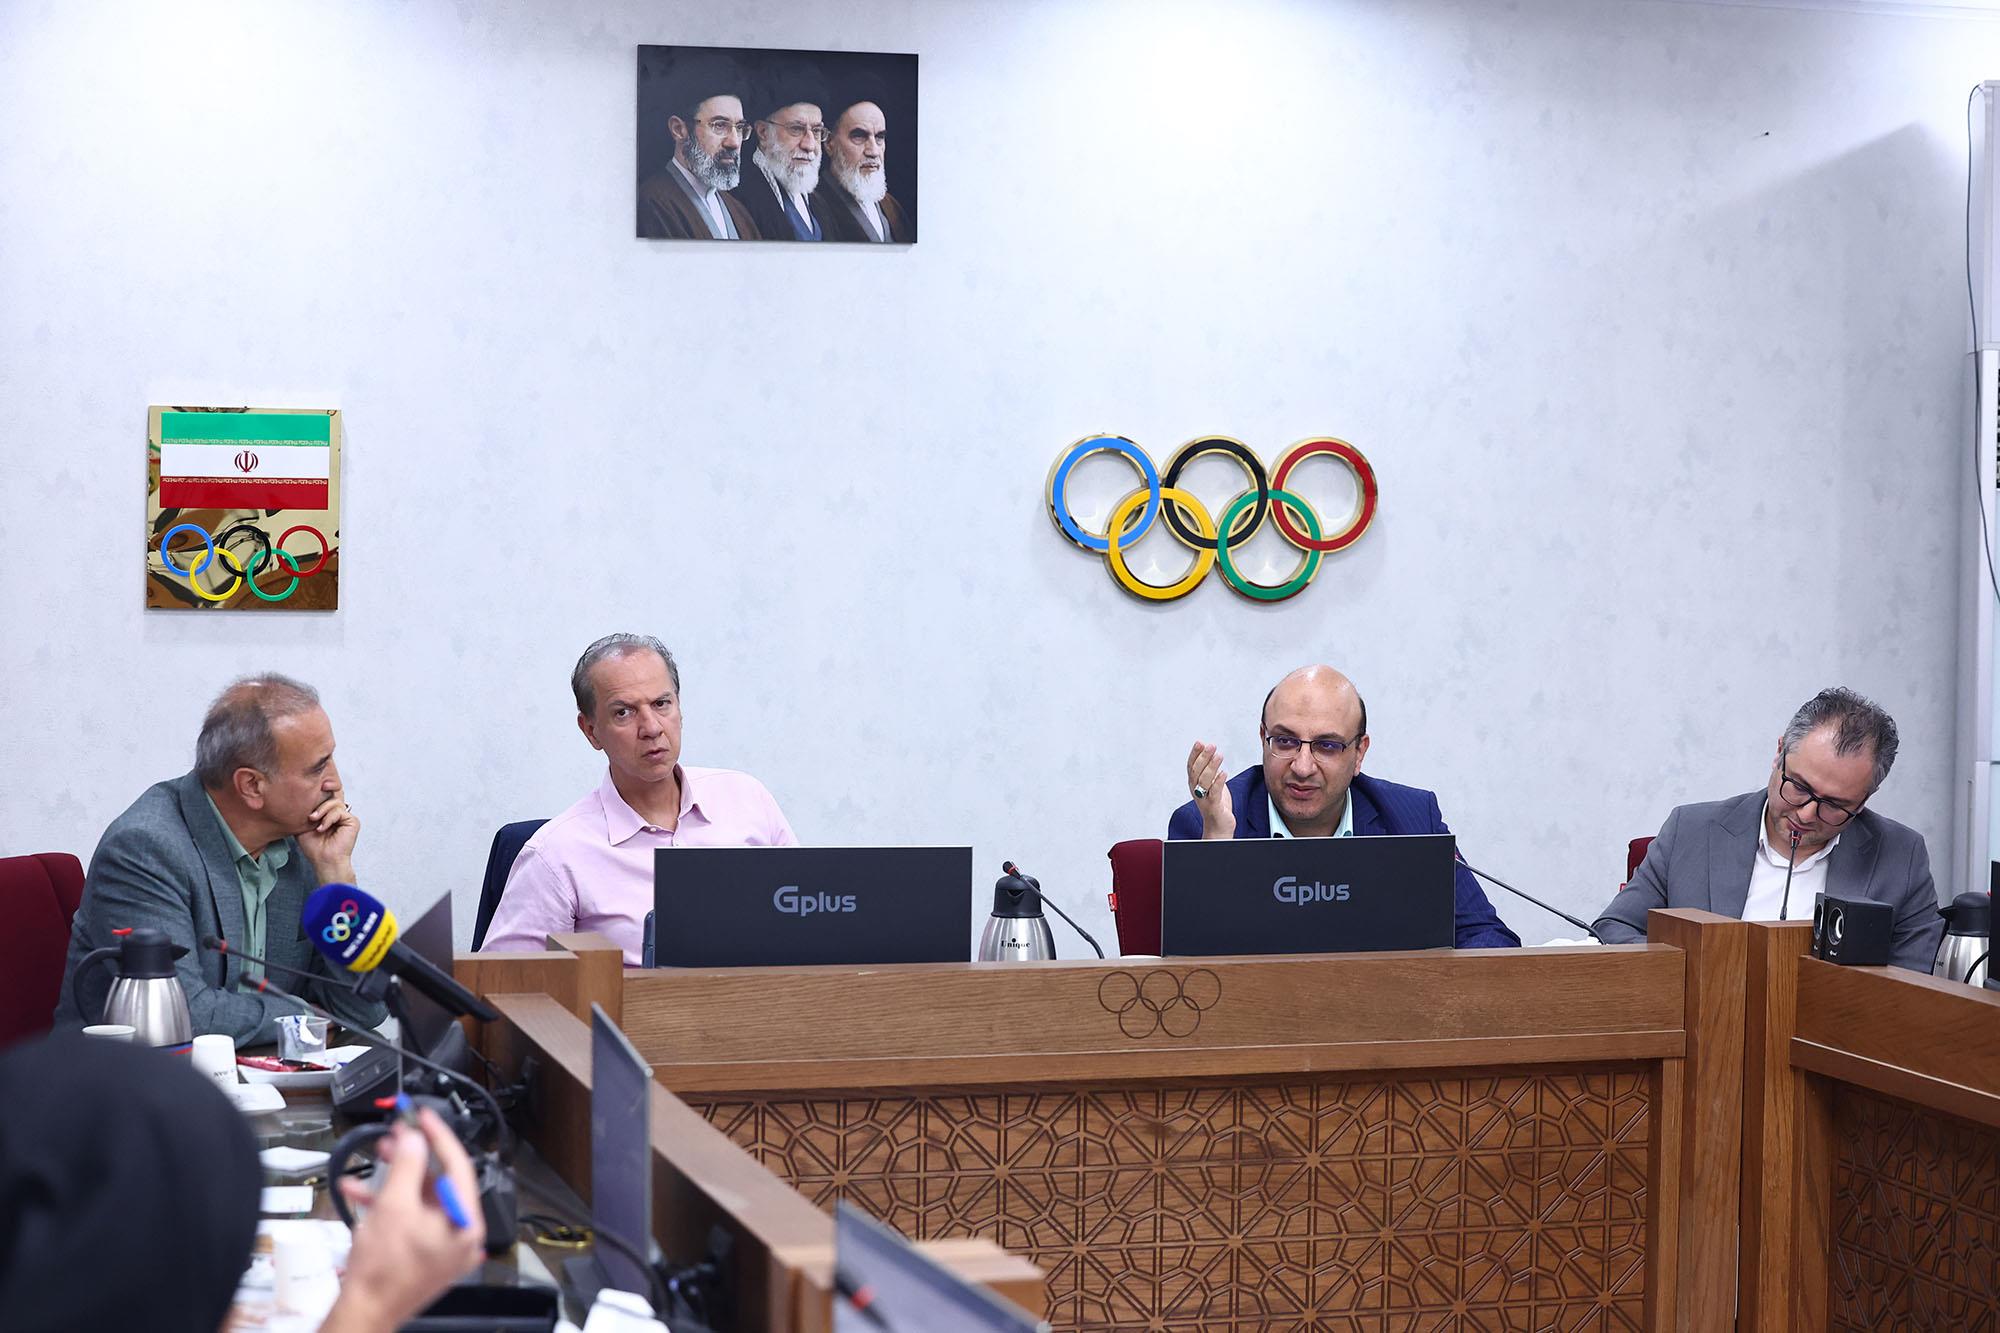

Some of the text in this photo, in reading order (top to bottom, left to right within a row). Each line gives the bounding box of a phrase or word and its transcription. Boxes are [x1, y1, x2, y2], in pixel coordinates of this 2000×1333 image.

[773, 885, 857, 917] Gplus
[1273, 876, 1350, 906] Gplus
[1001, 938, 1031, 949] Unique
